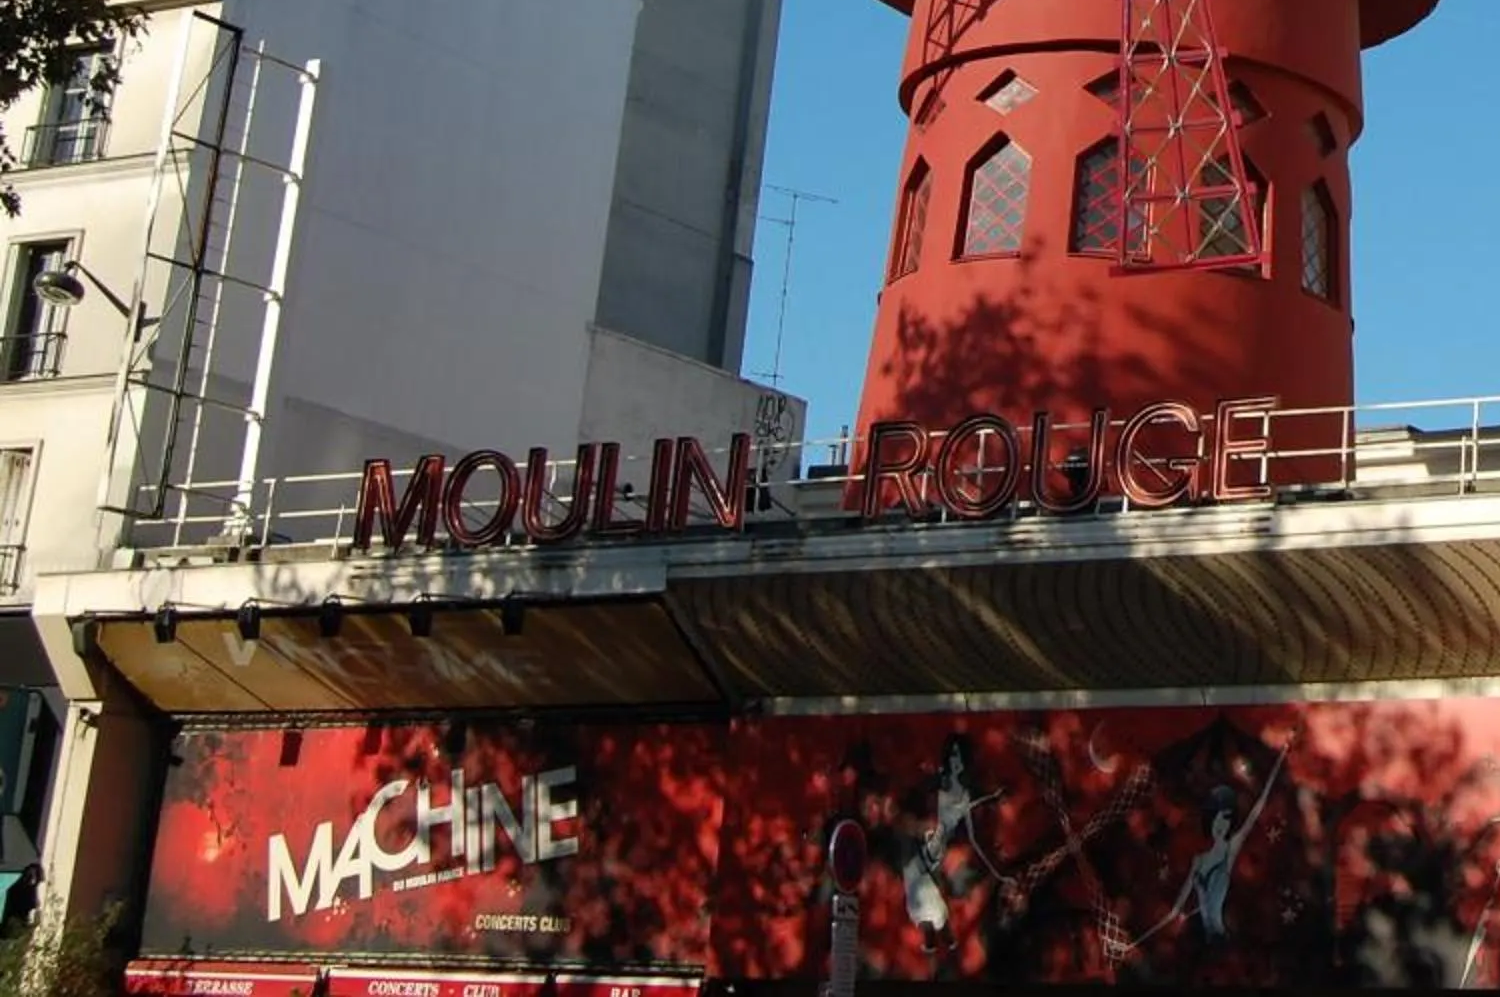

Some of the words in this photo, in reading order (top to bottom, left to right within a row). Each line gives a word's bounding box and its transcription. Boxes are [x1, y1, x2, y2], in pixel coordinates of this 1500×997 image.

[353, 433, 750, 552] MOULIN
[862, 397, 1280, 519] ROUGE
[267, 765, 578, 921] MACHINE
[475, 913, 537, 932] CONCERTS
[368, 979, 440, 997] CONCERTS
